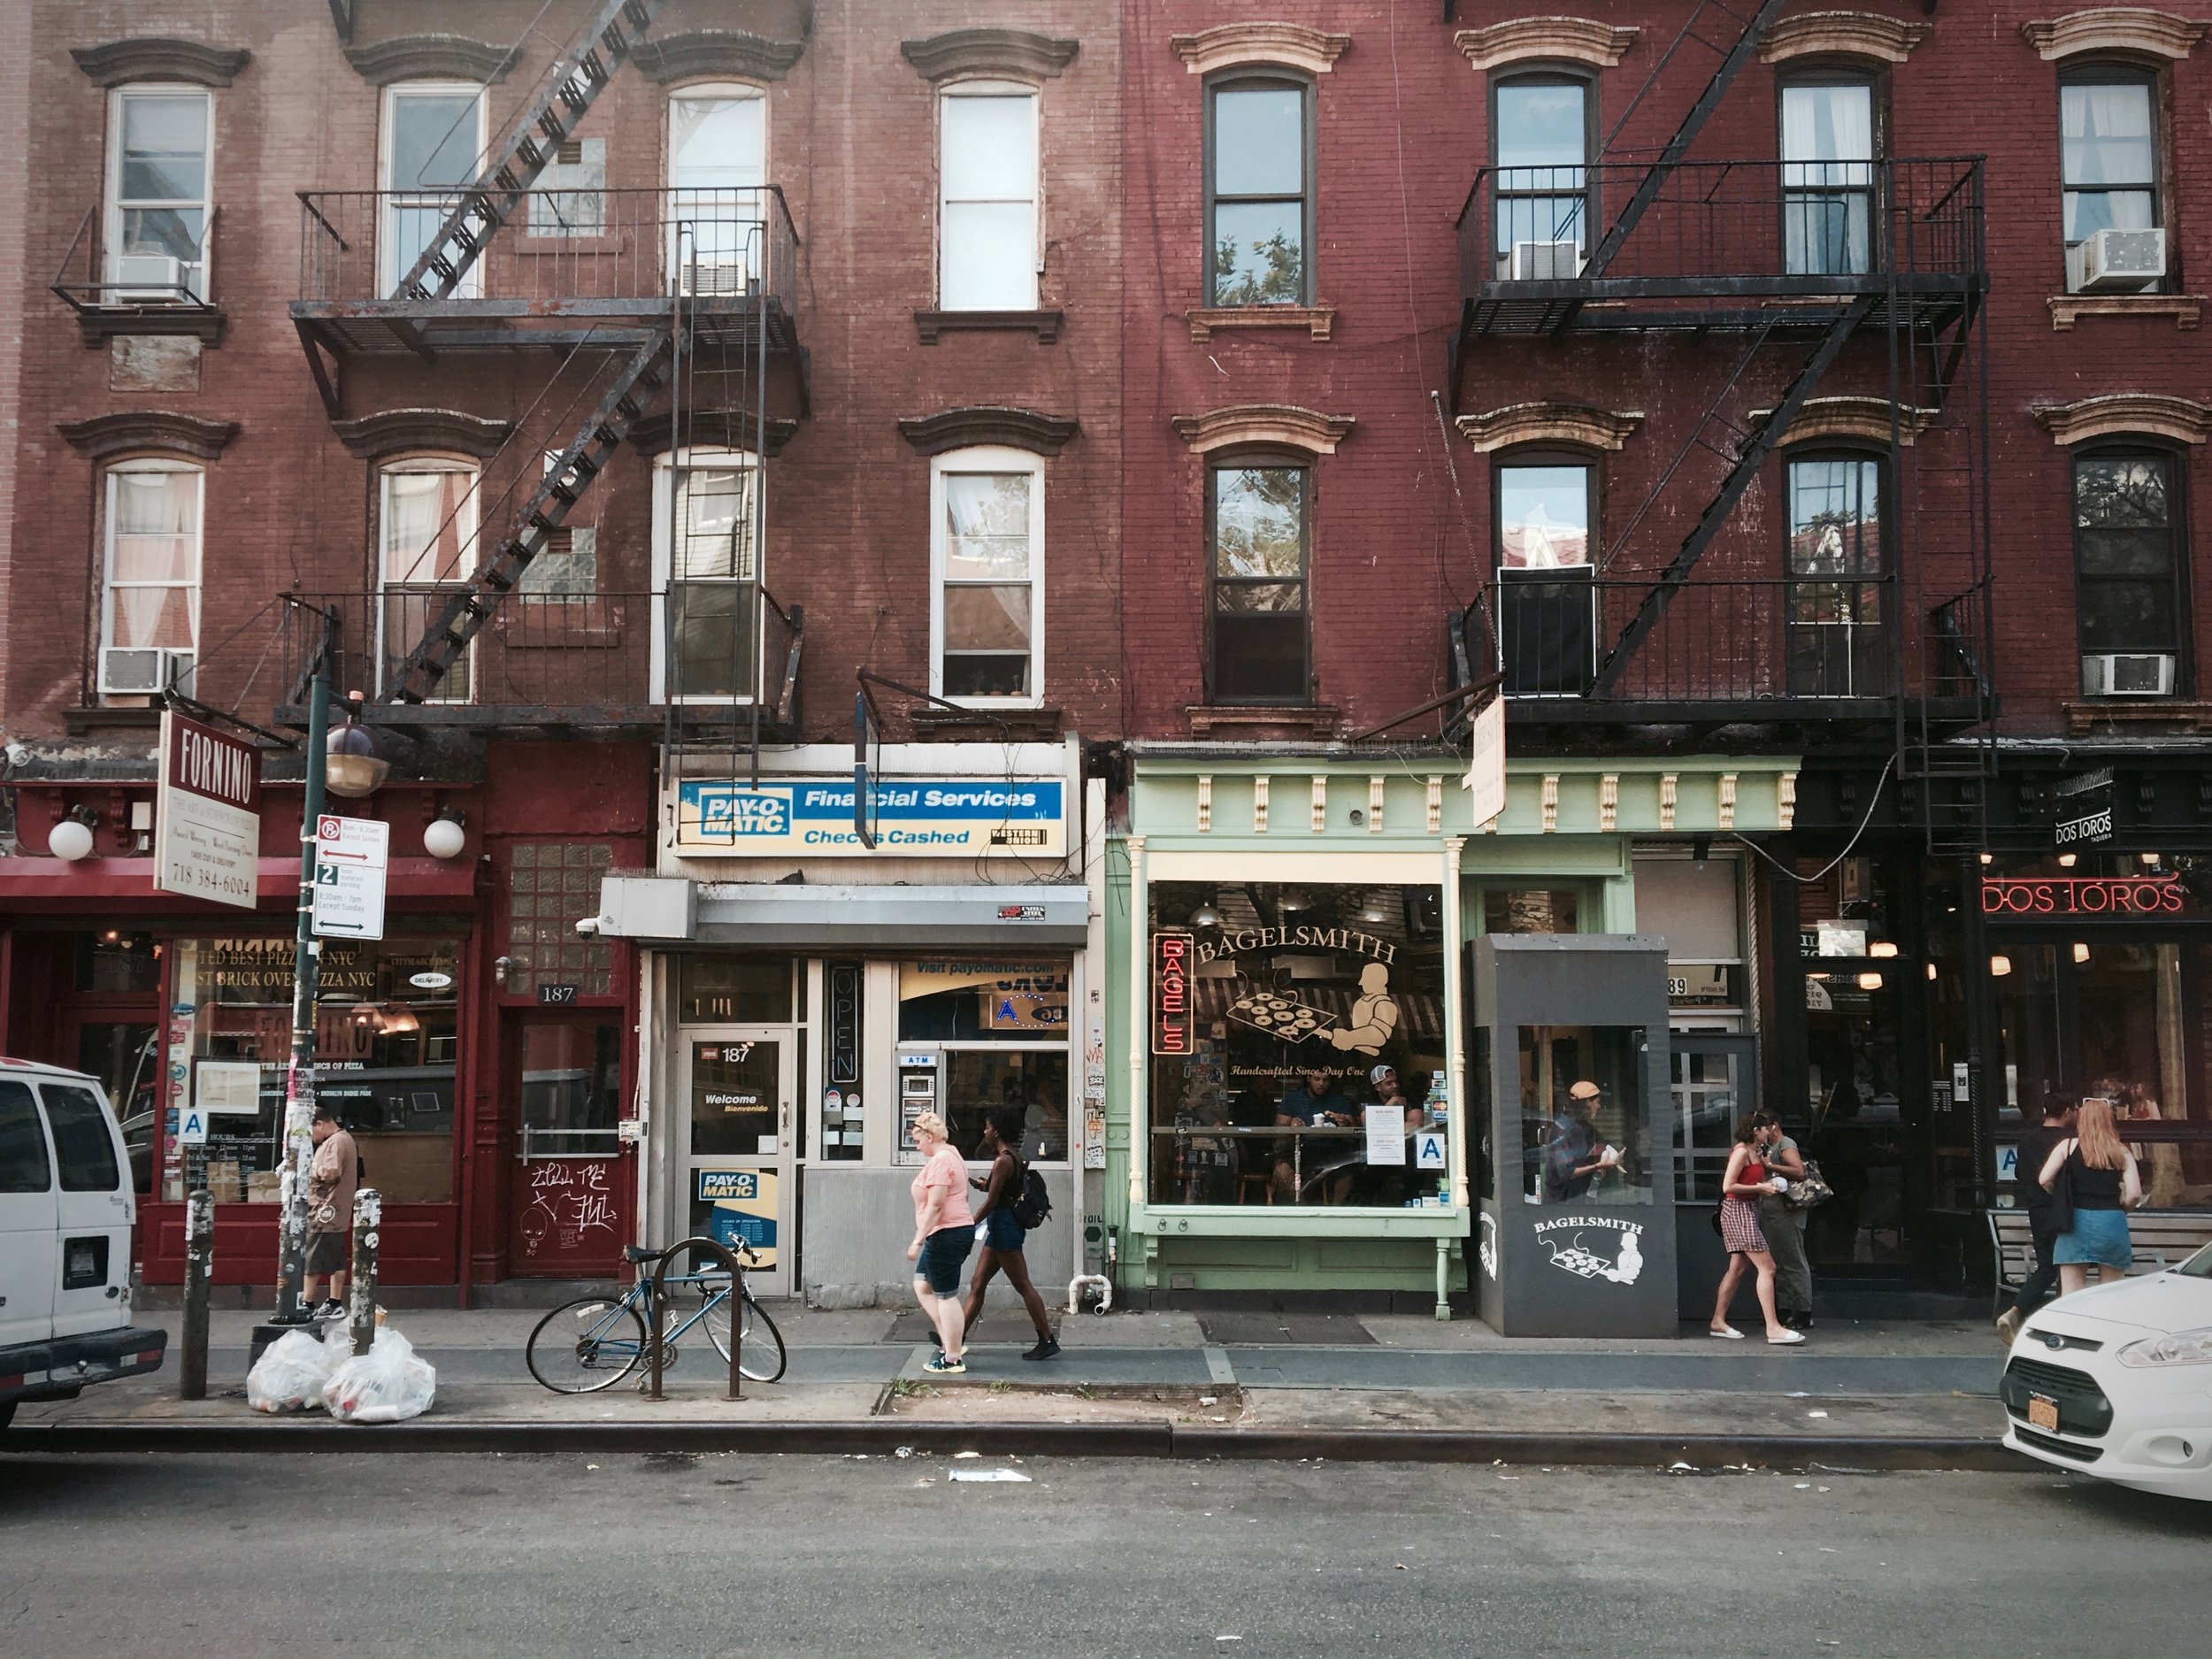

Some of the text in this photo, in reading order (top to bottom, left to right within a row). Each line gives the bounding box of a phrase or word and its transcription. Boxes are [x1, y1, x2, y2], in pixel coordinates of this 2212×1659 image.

[180, 728, 251, 803] FORNINO
[805, 790, 1036, 807] Finacial Services
[703, 816, 782, 833] MATIC
[2056, 815, 2112, 844] DOS TOROS
[804, 829, 970, 845] Checs Cashed
[173, 863, 192, 885] 718
[321, 865, 334, 883] 2
[1982, 880, 2182, 911] DOS TOROS
[1196, 926, 1397, 965] BAGELSMITH
[233, 951, 264, 965] BEST
[267, 951, 296, 965] PIZZ
[328, 952, 356, 965] NYC
[917, 963, 945, 973] Visit
[217, 971, 257, 986] BRICK
[348, 972, 374, 987] NYC
[543, 987, 573, 1002] 187
[1163, 941, 1184, 1050] BAGELS
[835, 972, 854, 1076] OPEN
[722, 1048, 749, 1062] 187
[1230, 1065, 1293, 1077] Handcrafted
[1321, 1065, 1344, 1078] Day
[1347, 1065, 1365, 1076] One
[705, 1094, 757, 1103] Welcome
[185, 1113, 201, 1133] A
[1422, 1138, 1440, 1158] A
[2002, 1149, 2017, 1171] A
[703, 1187, 753, 1196] MATIC
[1533, 1217, 1644, 1234] BAGELSMITH
